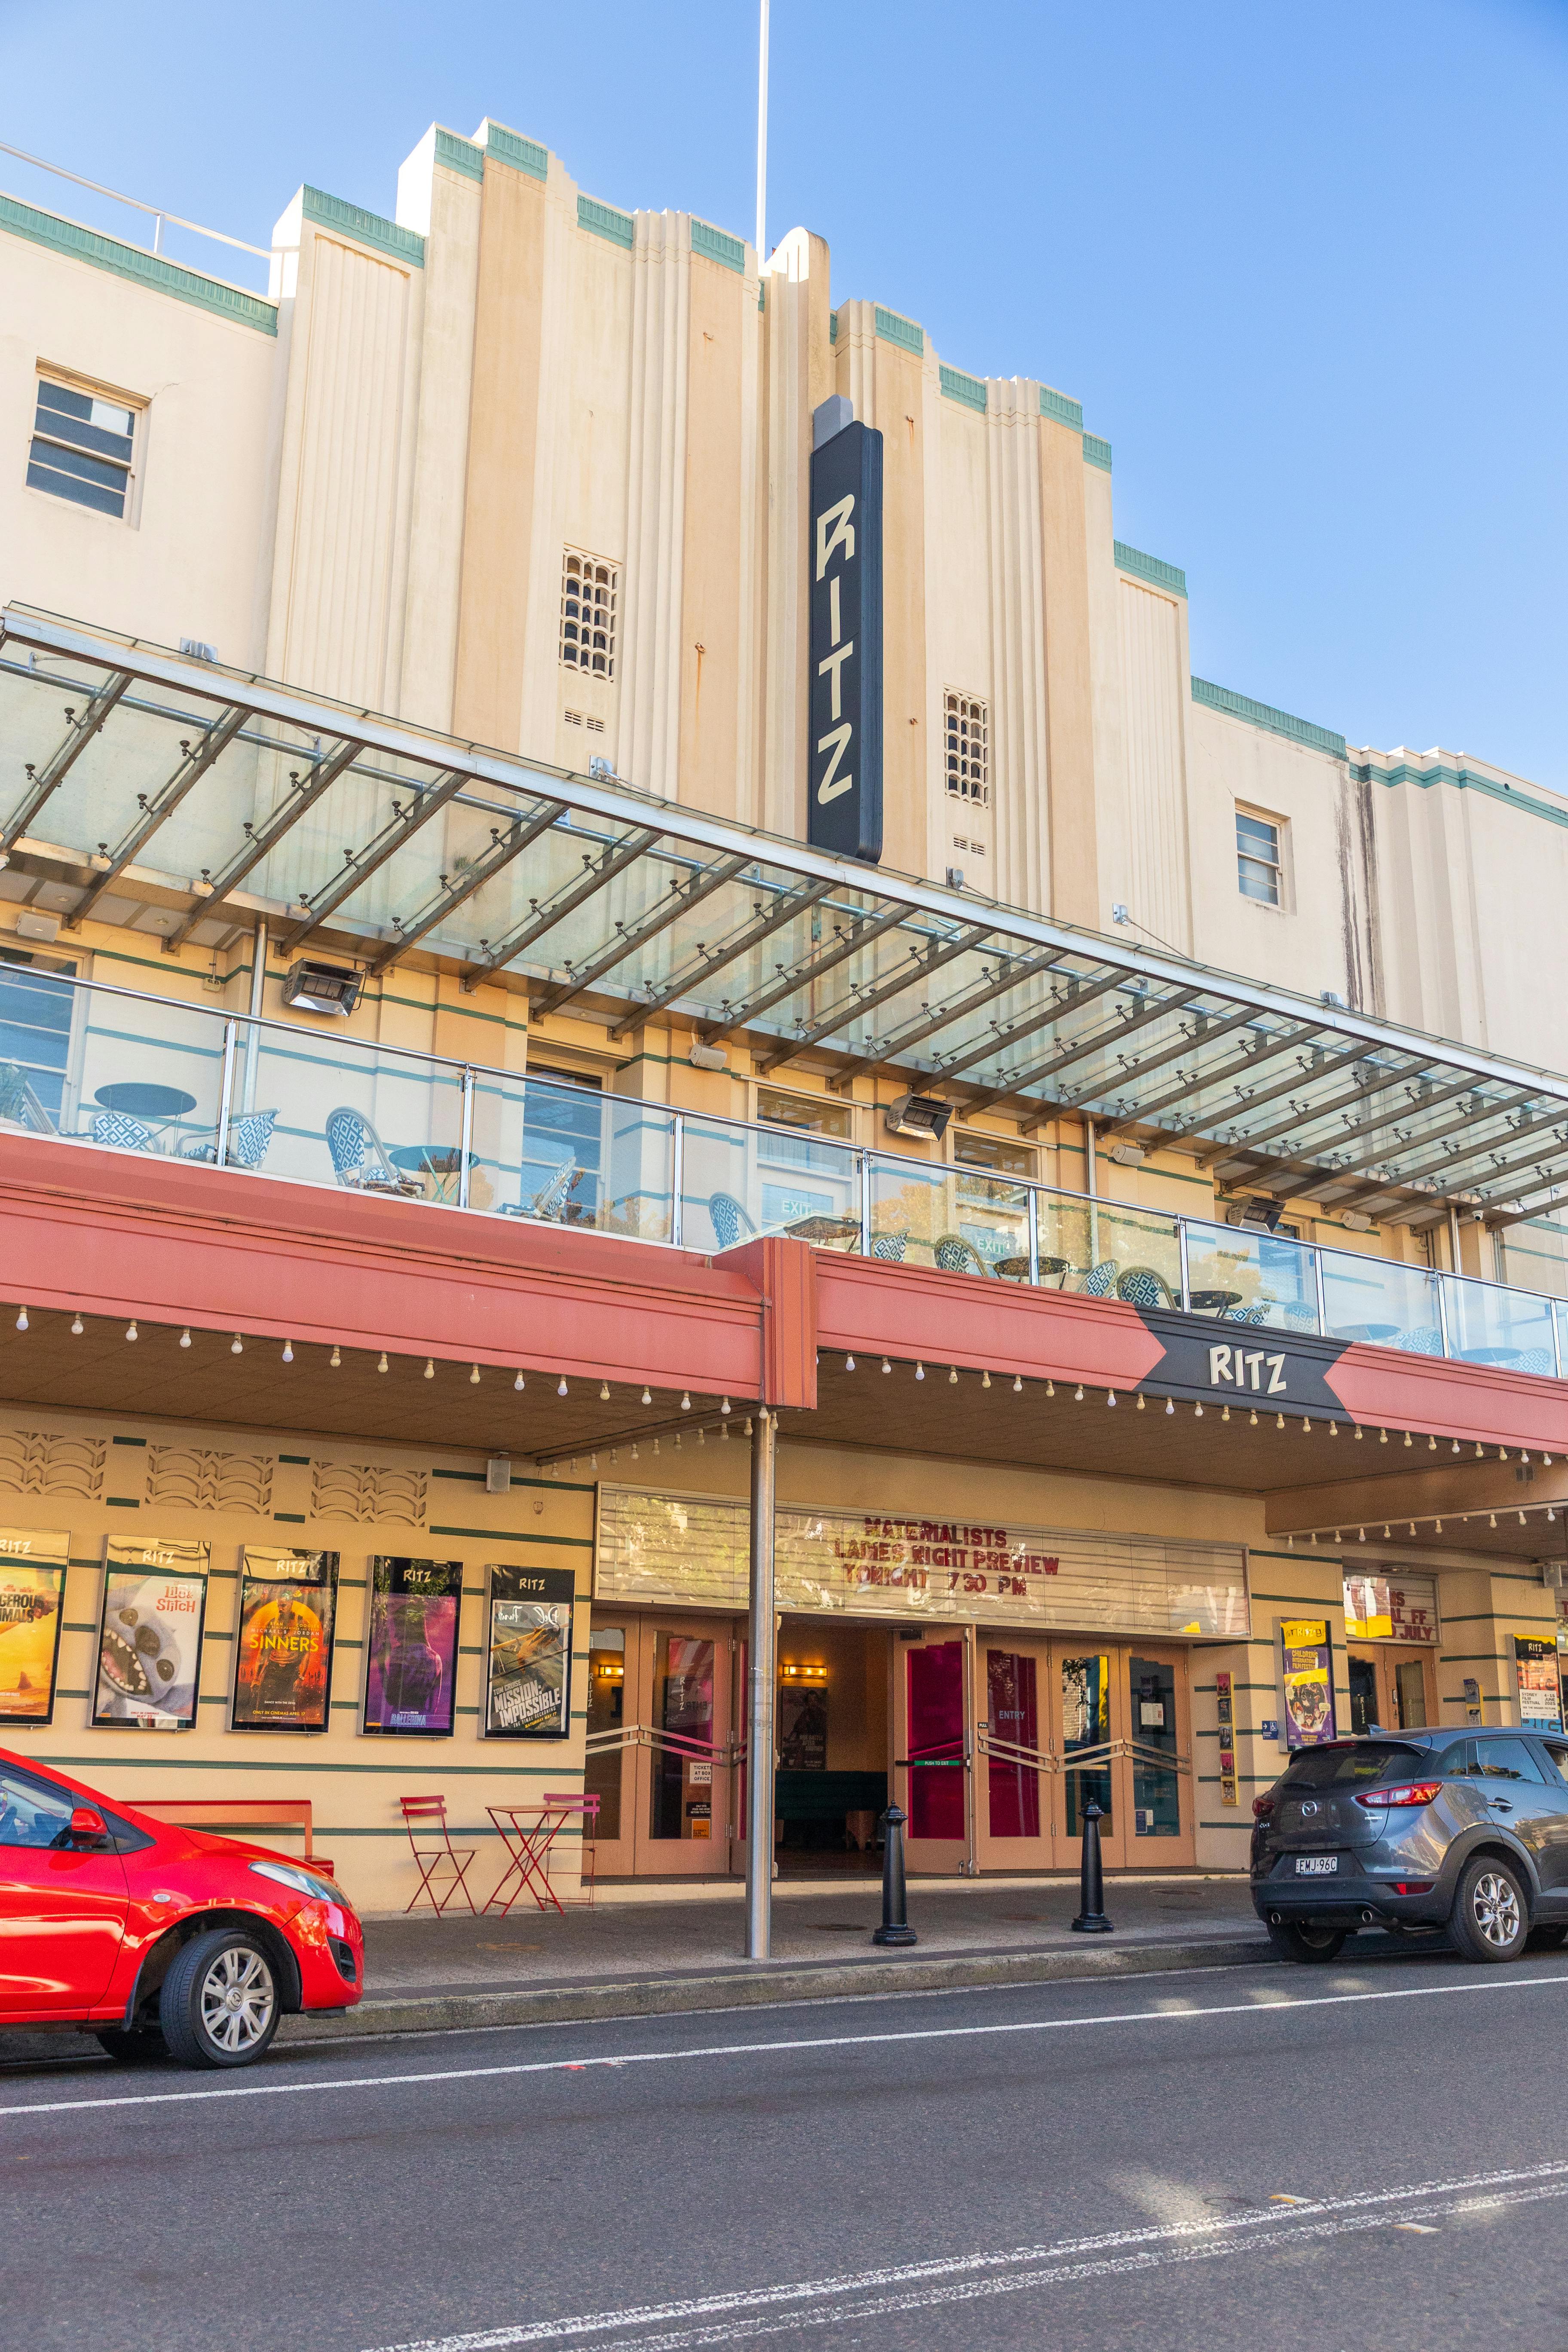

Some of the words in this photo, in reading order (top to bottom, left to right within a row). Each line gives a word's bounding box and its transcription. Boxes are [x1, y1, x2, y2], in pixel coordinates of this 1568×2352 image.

[816, 494, 855, 805] RITZ
[782, 1200, 811, 1217] EXIT
[977, 1238, 1004, 1253] EXIT
[1210, 1344, 1286, 1394] RITZ
[865, 1517, 1007, 1548] MATERIALISTS
[142, 1550, 175, 1564] RITZ
[835, 1538, 905, 1563] LADIES
[912, 1545, 968, 1569] NIGHT
[973, 1550, 1060, 1575] PREVIEW
[276, 1559, 306, 1574] RITZ
[403, 1569, 432, 1583] RITZ
[519, 1578, 545, 1590] RITZ
[845, 1563, 929, 1588] TONIGHT
[998, 1575, 1027, 1596] PM
[1411, 1609, 1427, 1625] FF
[1400, 1625, 1433, 1641] JULY
[249, 1634, 319, 1652] SINNERS
[1528, 1643, 1542, 1652] RITZ
[493, 1686, 504, 1696] TOM
[504, 1679, 522, 1692] CRUISE
[494, 1680, 542, 1713] MISSION:
[499, 1687, 561, 1728] IMPOSSIBLE
[522, 1716, 533, 1725] FINAL
[534, 1706, 556, 1720] RECKONING
[999, 1710, 1025, 1720] ENTRY
[390, 1713, 427, 1726] BALLERINA
[525, 1717, 544, 1728] SATURDAY
